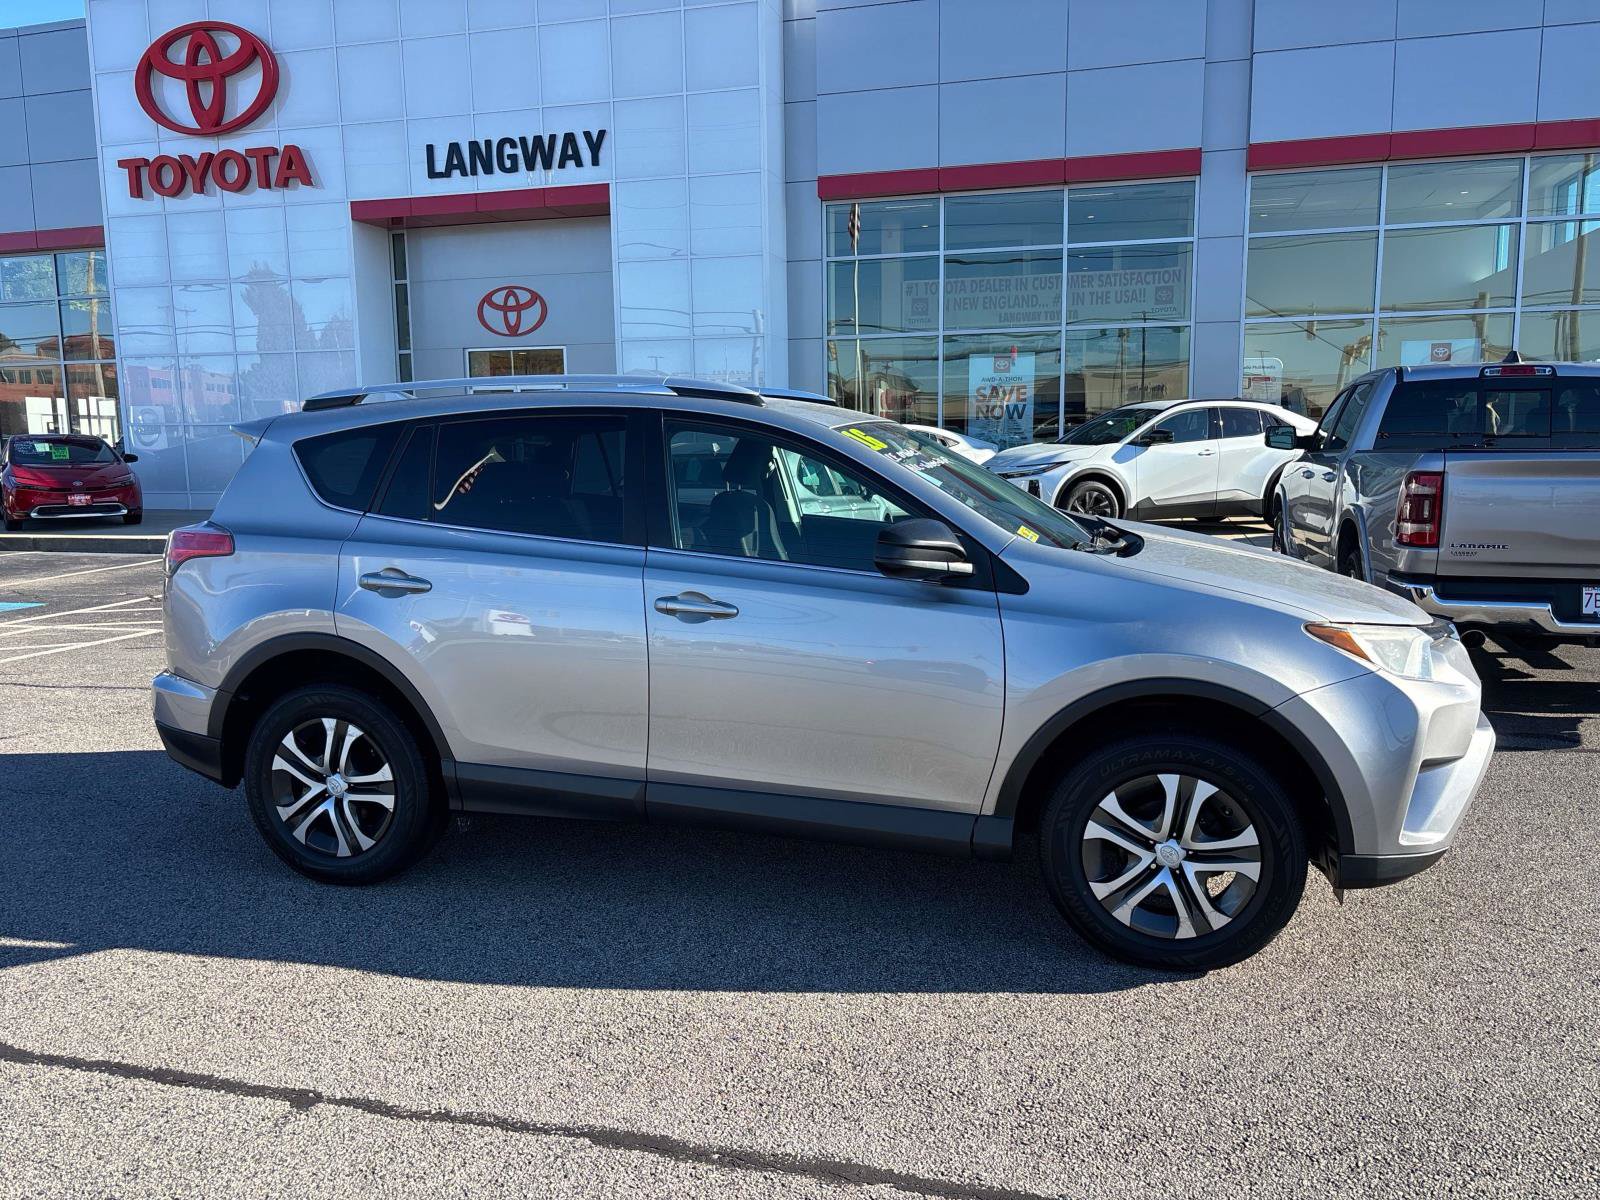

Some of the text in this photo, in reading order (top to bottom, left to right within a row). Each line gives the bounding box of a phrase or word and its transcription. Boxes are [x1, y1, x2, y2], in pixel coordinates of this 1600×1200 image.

[426, 129, 607, 180] LANGWAY
[117, 144, 315, 199] TOYOTA
[904, 284, 919, 297] #1
[924, 280, 967, 296] TOOTA
[970, 277, 1011, 293] DEALER
[1015, 277, 1028, 291] IN
[1098, 269, 1181, 288] SATISFACTION
[953, 296, 979, 312] NEW
[982, 293, 1049, 311] ENGLAND...
[1071, 291, 1085, 306] IN
[1088, 290, 1112, 306] THE
[1114, 287, 1146, 304] USA!!
[1000, 309, 1079, 323] LANGWAY TOYTA
[975, 384, 1028, 402] SAVE
[975, 403, 1027, 420] NOW
[1100, 748, 1200, 778] ULTRAMAX
